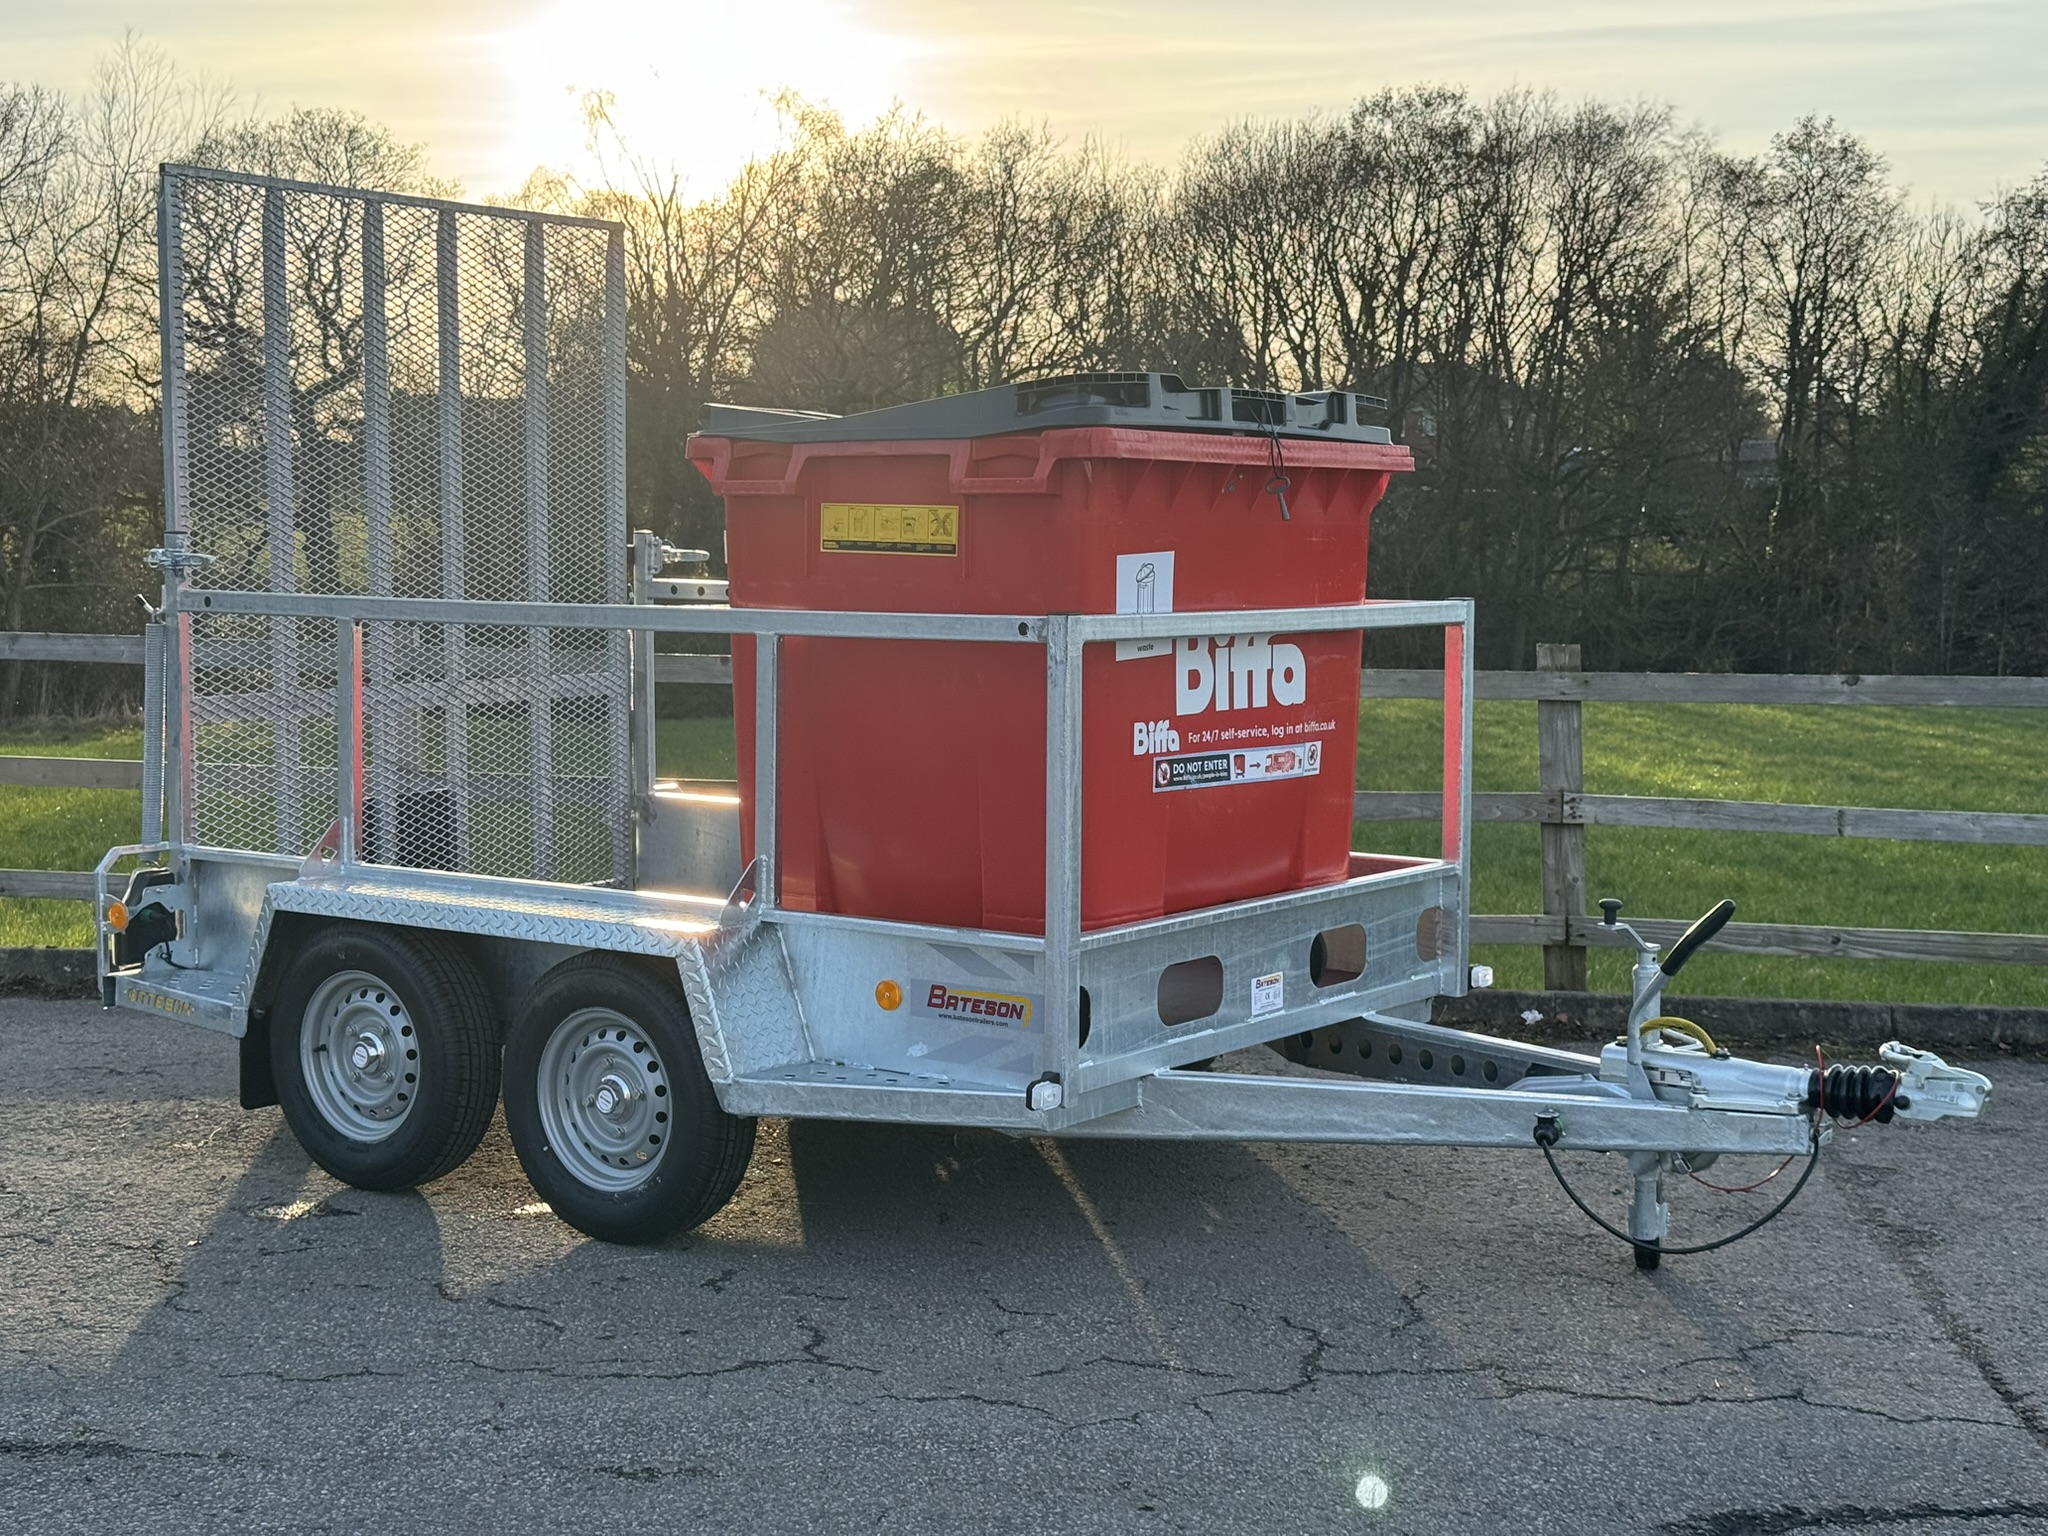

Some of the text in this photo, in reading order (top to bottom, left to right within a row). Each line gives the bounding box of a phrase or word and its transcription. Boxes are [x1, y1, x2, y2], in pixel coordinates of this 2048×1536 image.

[1136, 643, 1154, 652] waste
[1175, 634, 1307, 716] Biffa
[1133, 720, 1180, 756] Biffa
[1188, 719, 1337, 744] For 24/7 self-service, log in at biffa.co.uk
[1173, 759, 1229, 774] DO NOT ENTER
[927, 984, 1025, 1020] BATESON
[938, 1013, 1009, 1028] www.batesontrailers.com
